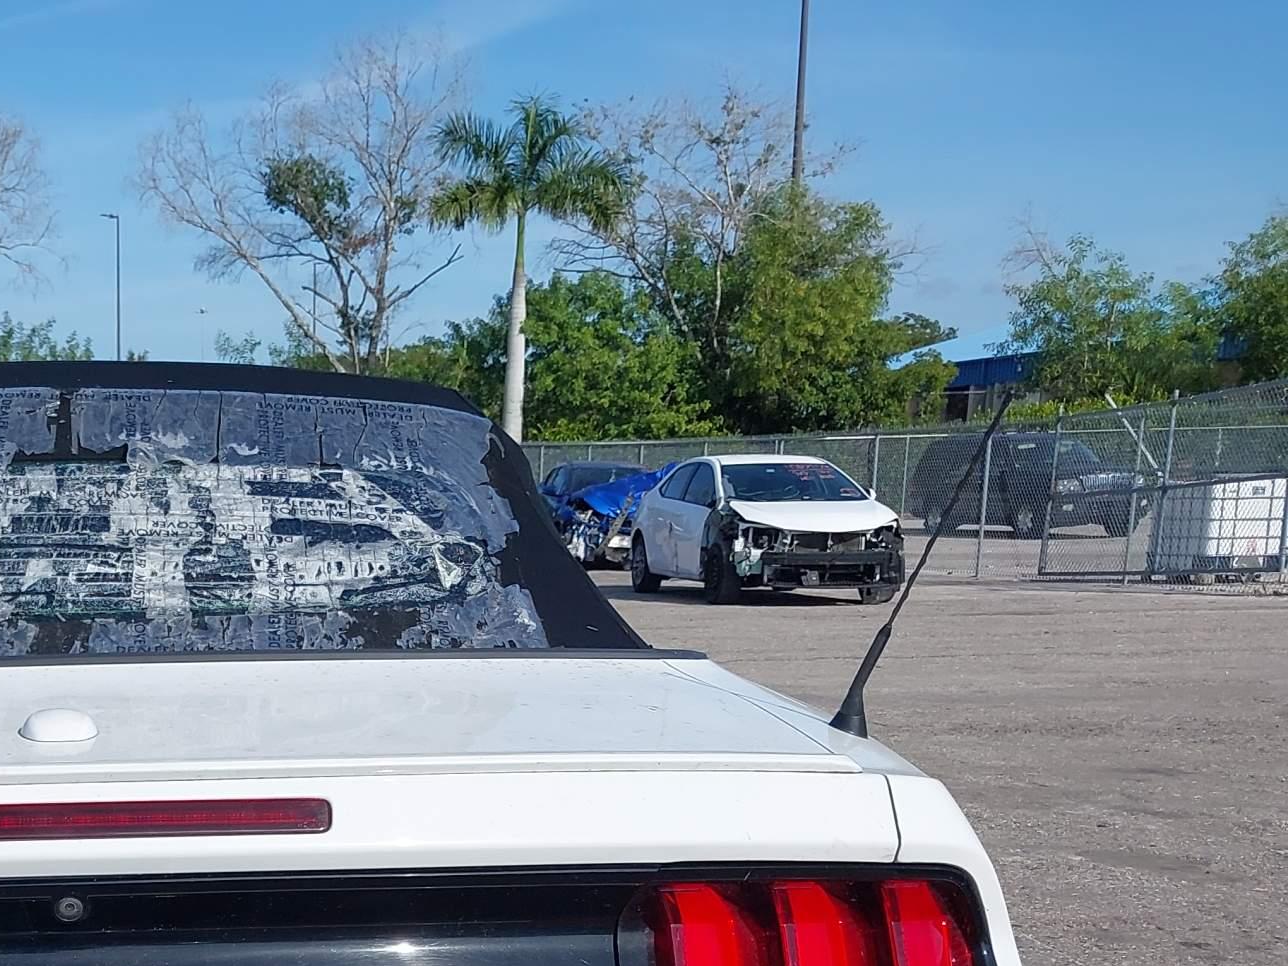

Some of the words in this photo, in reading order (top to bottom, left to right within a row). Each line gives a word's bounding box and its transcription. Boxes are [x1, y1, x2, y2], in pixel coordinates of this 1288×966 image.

[321, 406, 356, 415] MUST
[262, 506, 349, 519] PROTECTIVE
[357, 511, 402, 523] COVER
[152, 519, 200, 530] COVER
[117, 527, 179, 538] REMOVE
[134, 536, 147, 569] DEALER
